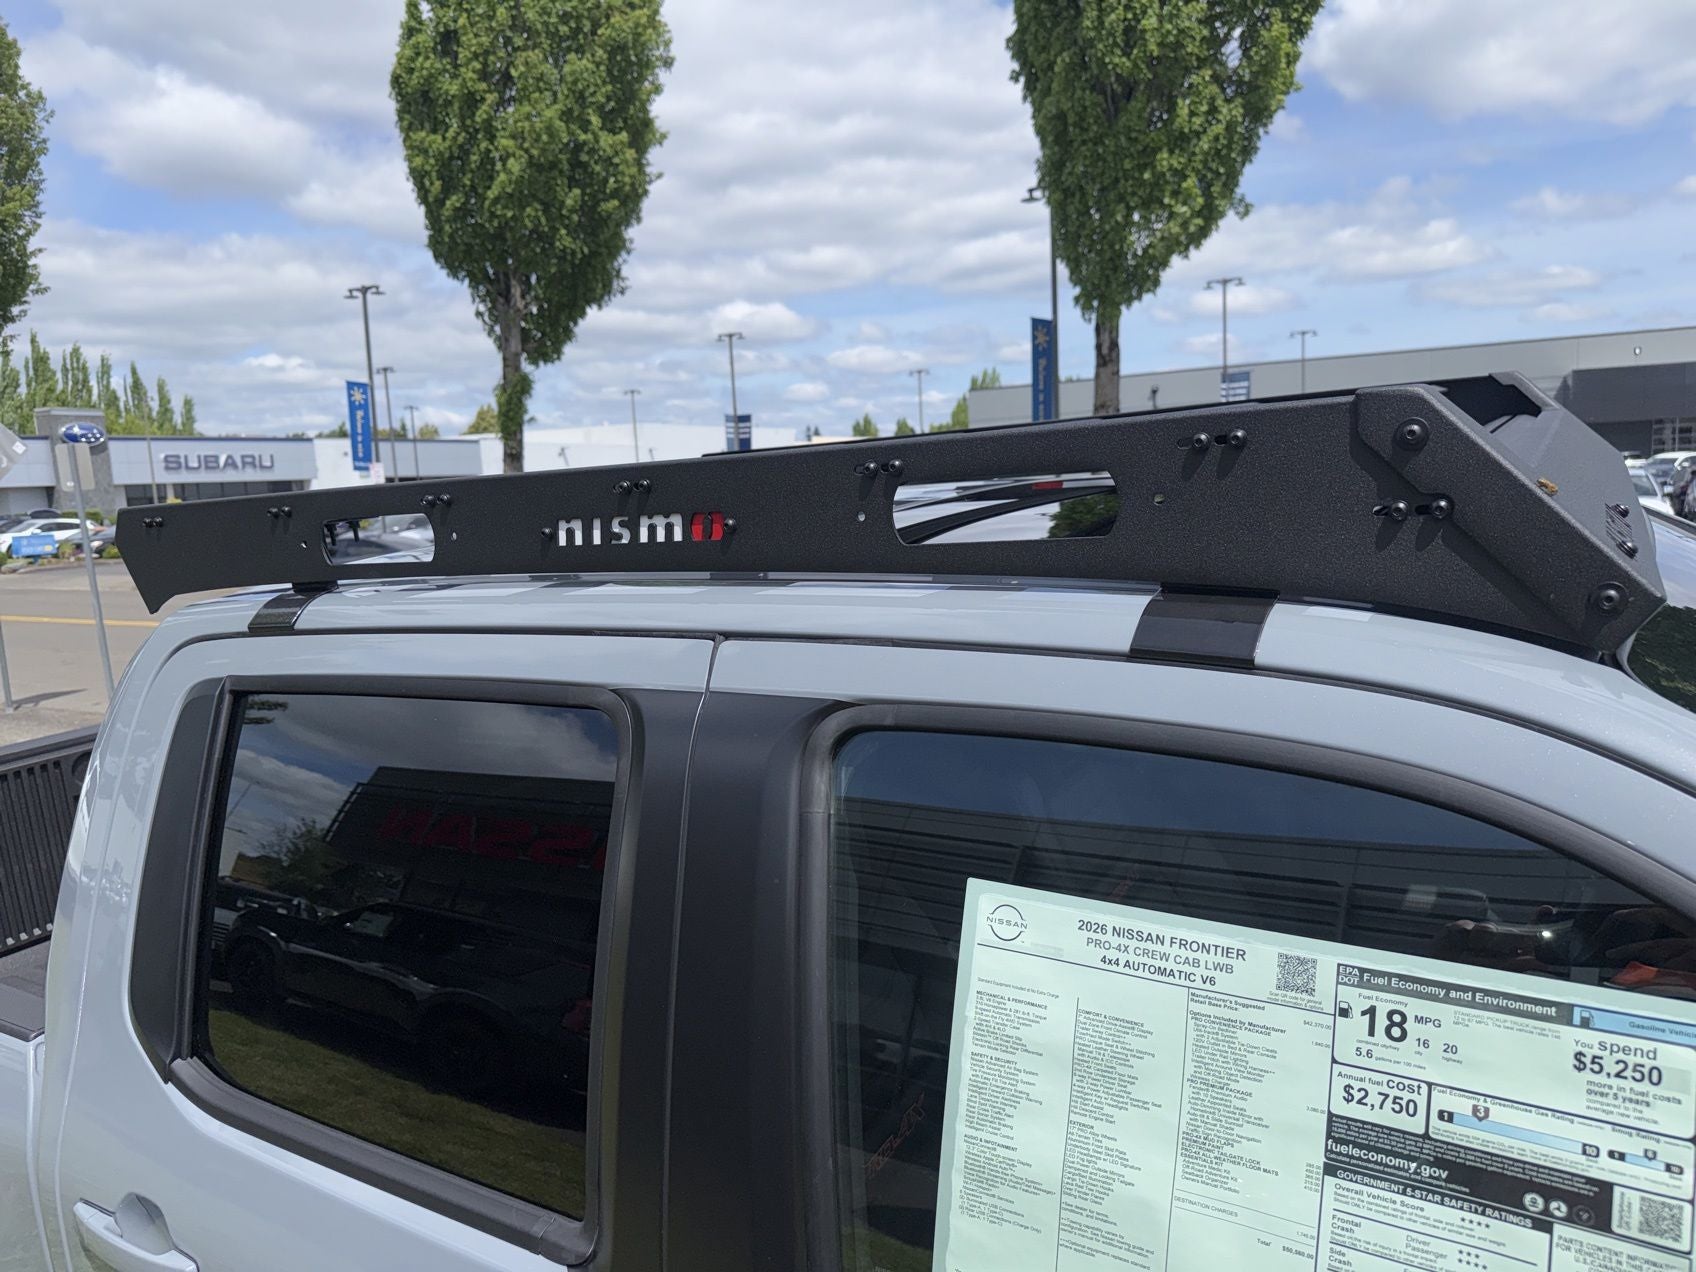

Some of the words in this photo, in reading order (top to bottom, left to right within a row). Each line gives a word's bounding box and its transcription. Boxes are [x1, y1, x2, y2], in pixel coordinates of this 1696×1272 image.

[164, 454, 274, 470] SUBARU
[558, 511, 724, 547] nismo
[986, 916, 1028, 930] NISSAN
[1078, 919, 1108, 935] 2026
[1112, 926, 1165, 946] NISSAN
[1169, 937, 1247, 961] FRONTIER
[1086, 937, 1131, 955] PRO-4X
[1134, 946, 1171, 964] CREW
[1173, 954, 1201, 968] CAB
[1204, 960, 1234, 974] LWB
[1100, 955, 1120, 968] 4x4
[1123, 960, 1197, 983] AUTOMATIC
[1200, 975, 1216, 986] V6
[1338, 975, 1360, 985] DOT
[1339, 966, 1360, 976] EPA
[976, 990, 1007, 1001] MECHANICAL
[1011, 997, 1048, 1010] PERFORMANCE
[1190, 992, 1233, 1005] Manufacturer's
[1234, 999, 1266, 1012] Suggested
[1358, 993, 1374, 1001] Fuel
[1375, 996, 1408, 1008] Economy
[1363, 972, 1388, 986] Fuel
[1391, 978, 1446, 998] Economy
[1448, 990, 1472, 1001] and
[1475, 992, 1557, 1016] Environment
[1078, 1008, 1103, 1018] COMFORT
[1108, 1014, 1144, 1028] CONVENIENCE
[1190, 1010, 1212, 1021] Options
[1213, 1014, 1238, 1025] Included
[1248, 1021, 1286, 1034] Manufacturer
[1190, 1015, 1203, 1023] PRO
[1204, 1018, 1244, 1031] CONVENIENCE
[1244, 1026, 1272, 1036] PACKAGE
[1360, 1004, 1408, 1042] 18
[1414, 1014, 1442, 1028] MPG
[1629, 1021, 1666, 1034] Gasoline
[1355, 1046, 1374, 1059] 5.6
[1416, 1038, 1430, 1049] 16
[1442, 1043, 1458, 1055] 20
[1574, 1038, 1594, 1050] You
[1598, 1040, 1657, 1060] spend
[971, 1051, 989, 1060] SAFETY
[994, 1055, 1017, 1066] SECURITY
[1442, 1055, 1462, 1065] highway
[1573, 1050, 1662, 1086] $5,250
[1187, 1077, 1199, 1085] PRO
[1226, 1086, 1253, 1098] PACKAGE
[1337, 1071, 1366, 1083] Annual
[1368, 1077, 1384, 1087] fuel
[1342, 1084, 1418, 1118] $2,750
[1586, 1080, 1614, 1090] more
[1616, 1084, 1626, 1092] in
[1629, 1086, 1650, 1098] fuel
[1652, 1094, 1682, 1105] costs
[1586, 1088, 1610, 1098] over
[1612, 1092, 1618, 1100] 5
[1621, 1095, 1650, 1108] years
[1433, 1087, 1448, 1095] Fuel
[1449, 1090, 1481, 1102] Economy
[1490, 1098, 1532, 1114] Greenhouse
[1534, 1108, 1549, 1118] Gas
[1551, 1112, 1574, 1124] Rating
[1476, 1105, 1485, 1117] 3
[1070, 1119, 1094, 1130] EXTERIOR
[1443, 1112, 1448, 1120] 1
[1584, 1146, 1598, 1156] 10
[964, 1133, 979, 1142] AUDIO
[983, 1138, 1018, 1152] INFOTAINMENT
[1182, 1136, 1208, 1147] PREMIUM
[1208, 1142, 1224, 1151] PAINT
[1217, 1139, 1234, 1148] FLAPS
[1180, 1152, 1214, 1165] ESSENTIALS
[1214, 1160, 1223, 1168] KIT
[1181, 1140, 1217, 1155] ELECTRONIC
[1217, 1149, 1245, 1161] TAILGATE
[1245, 1156, 1261, 1165] LOCK
[1328, 1138, 1448, 1179] fueleconomy.gov
[1243, 1162, 1262, 1172] FLOOR
[1263, 1167, 1279, 1176] MATS
[1174, 1195, 1211, 1210] DESTINATION
[1211, 1205, 1238, 1218] CHARGES
[1334, 1182, 1364, 1196] Overall
[1366, 1191, 1397, 1205] Vehicle
[1400, 1200, 1424, 1212] Score
[1336, 1170, 1404, 1194] GOVERNMENT
[1406, 1187, 1442, 1203] 5-STAR
[1444, 1197, 1484, 1214] SAFETY
[1485, 1208, 1532, 1228] RATINGS
[1331, 1222, 1355, 1234] Crash
[1332, 1214, 1362, 1228] Frontal
[1257, 1238, 1271, 1246] Total
[1406, 1235, 1431, 1246] Driver
[1329, 1248, 1346, 1258] Side
[1406, 1243, 1448, 1260] Passenger
[1328, 1256, 1352, 1267] Crash
